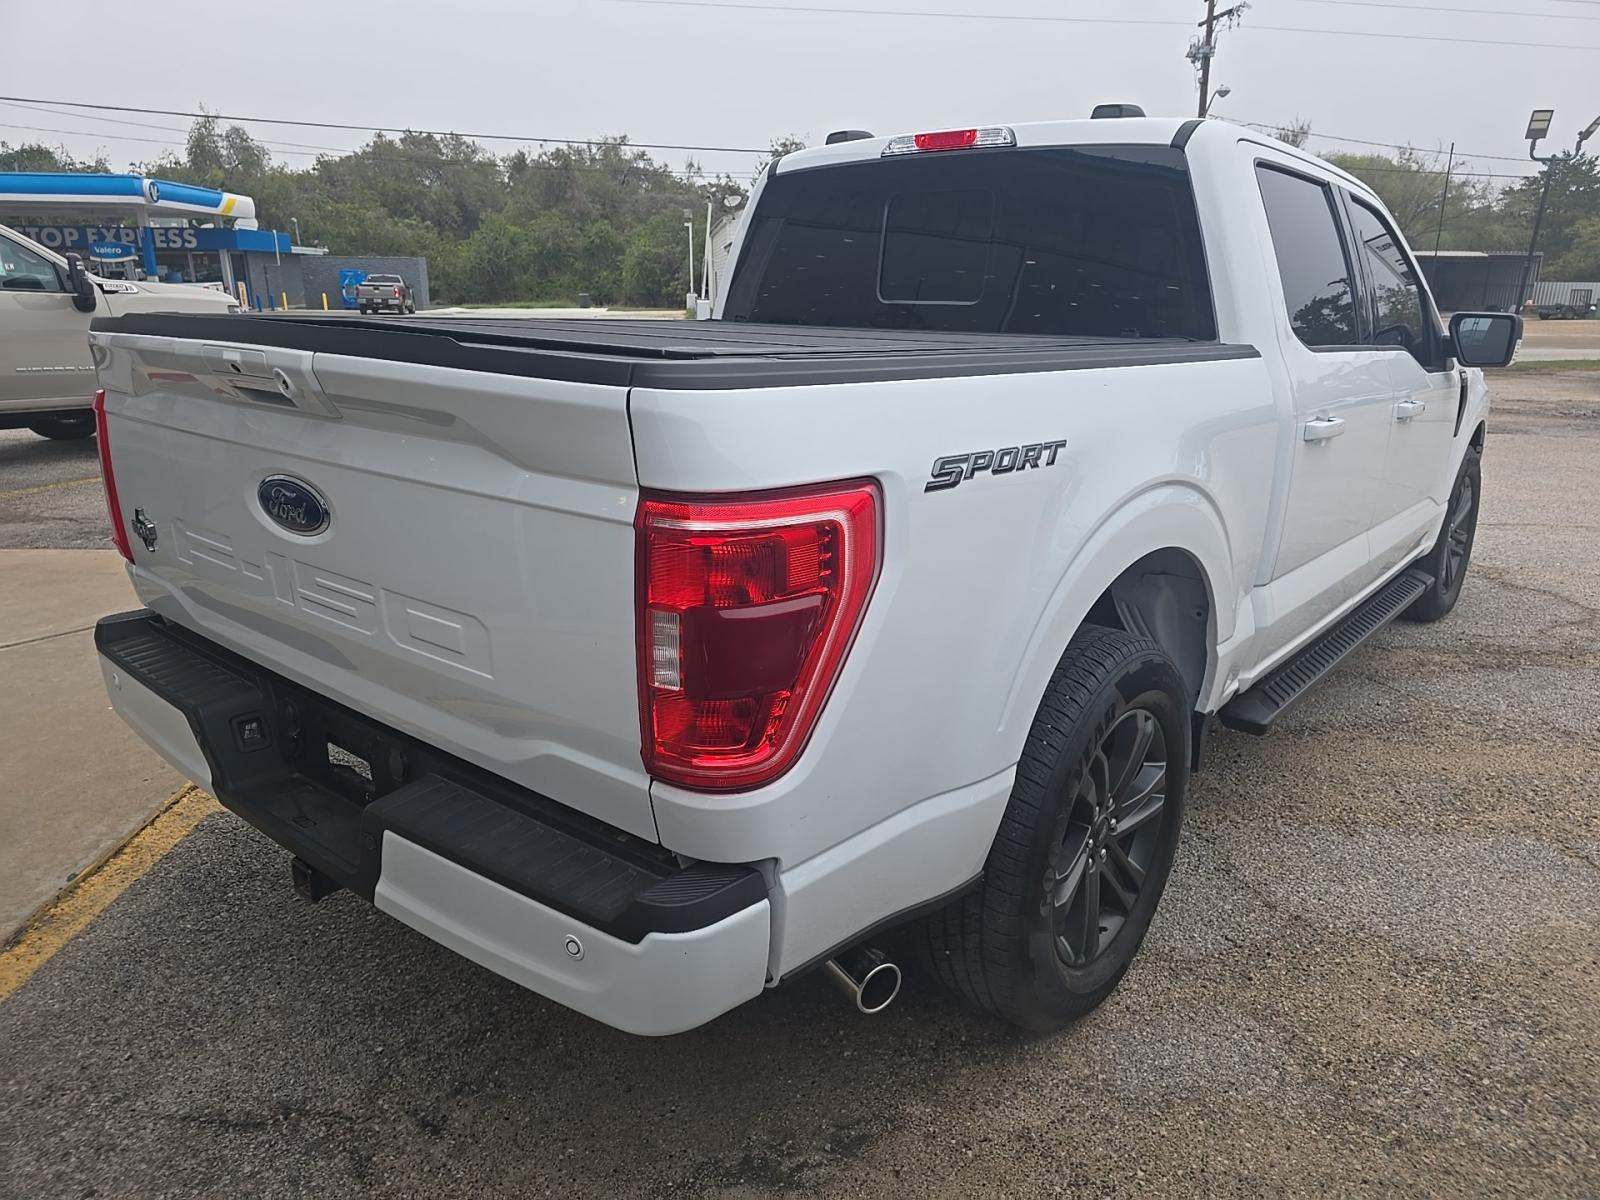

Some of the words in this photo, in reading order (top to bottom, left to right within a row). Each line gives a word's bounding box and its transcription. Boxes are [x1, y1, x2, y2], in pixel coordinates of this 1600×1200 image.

[13, 226, 79, 247] TOP
[86, 227, 198, 249] EXPESS
[94, 246, 122, 254] Valero
[924, 440, 1068, 493] SPORT
[269, 486, 307, 525] Ford
[170, 516, 495, 681] F-150
